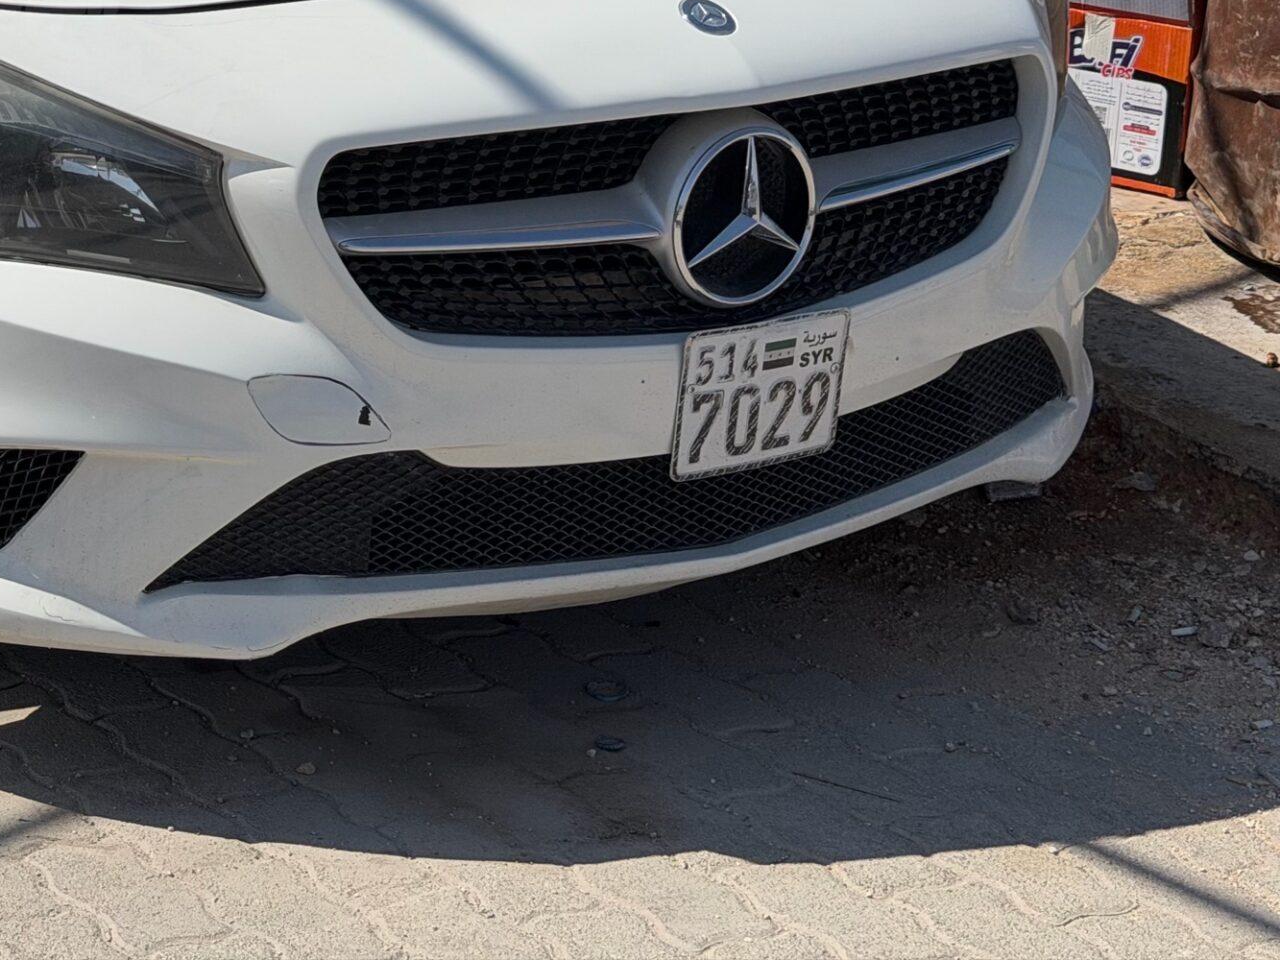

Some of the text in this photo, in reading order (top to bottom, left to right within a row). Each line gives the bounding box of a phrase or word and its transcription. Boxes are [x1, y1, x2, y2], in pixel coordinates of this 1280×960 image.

[803, 330, 838, 347] سورية
[695, 340, 759, 386] 514
[799, 346, 834, 368] SYR
[688, 371, 831, 464] 7029
